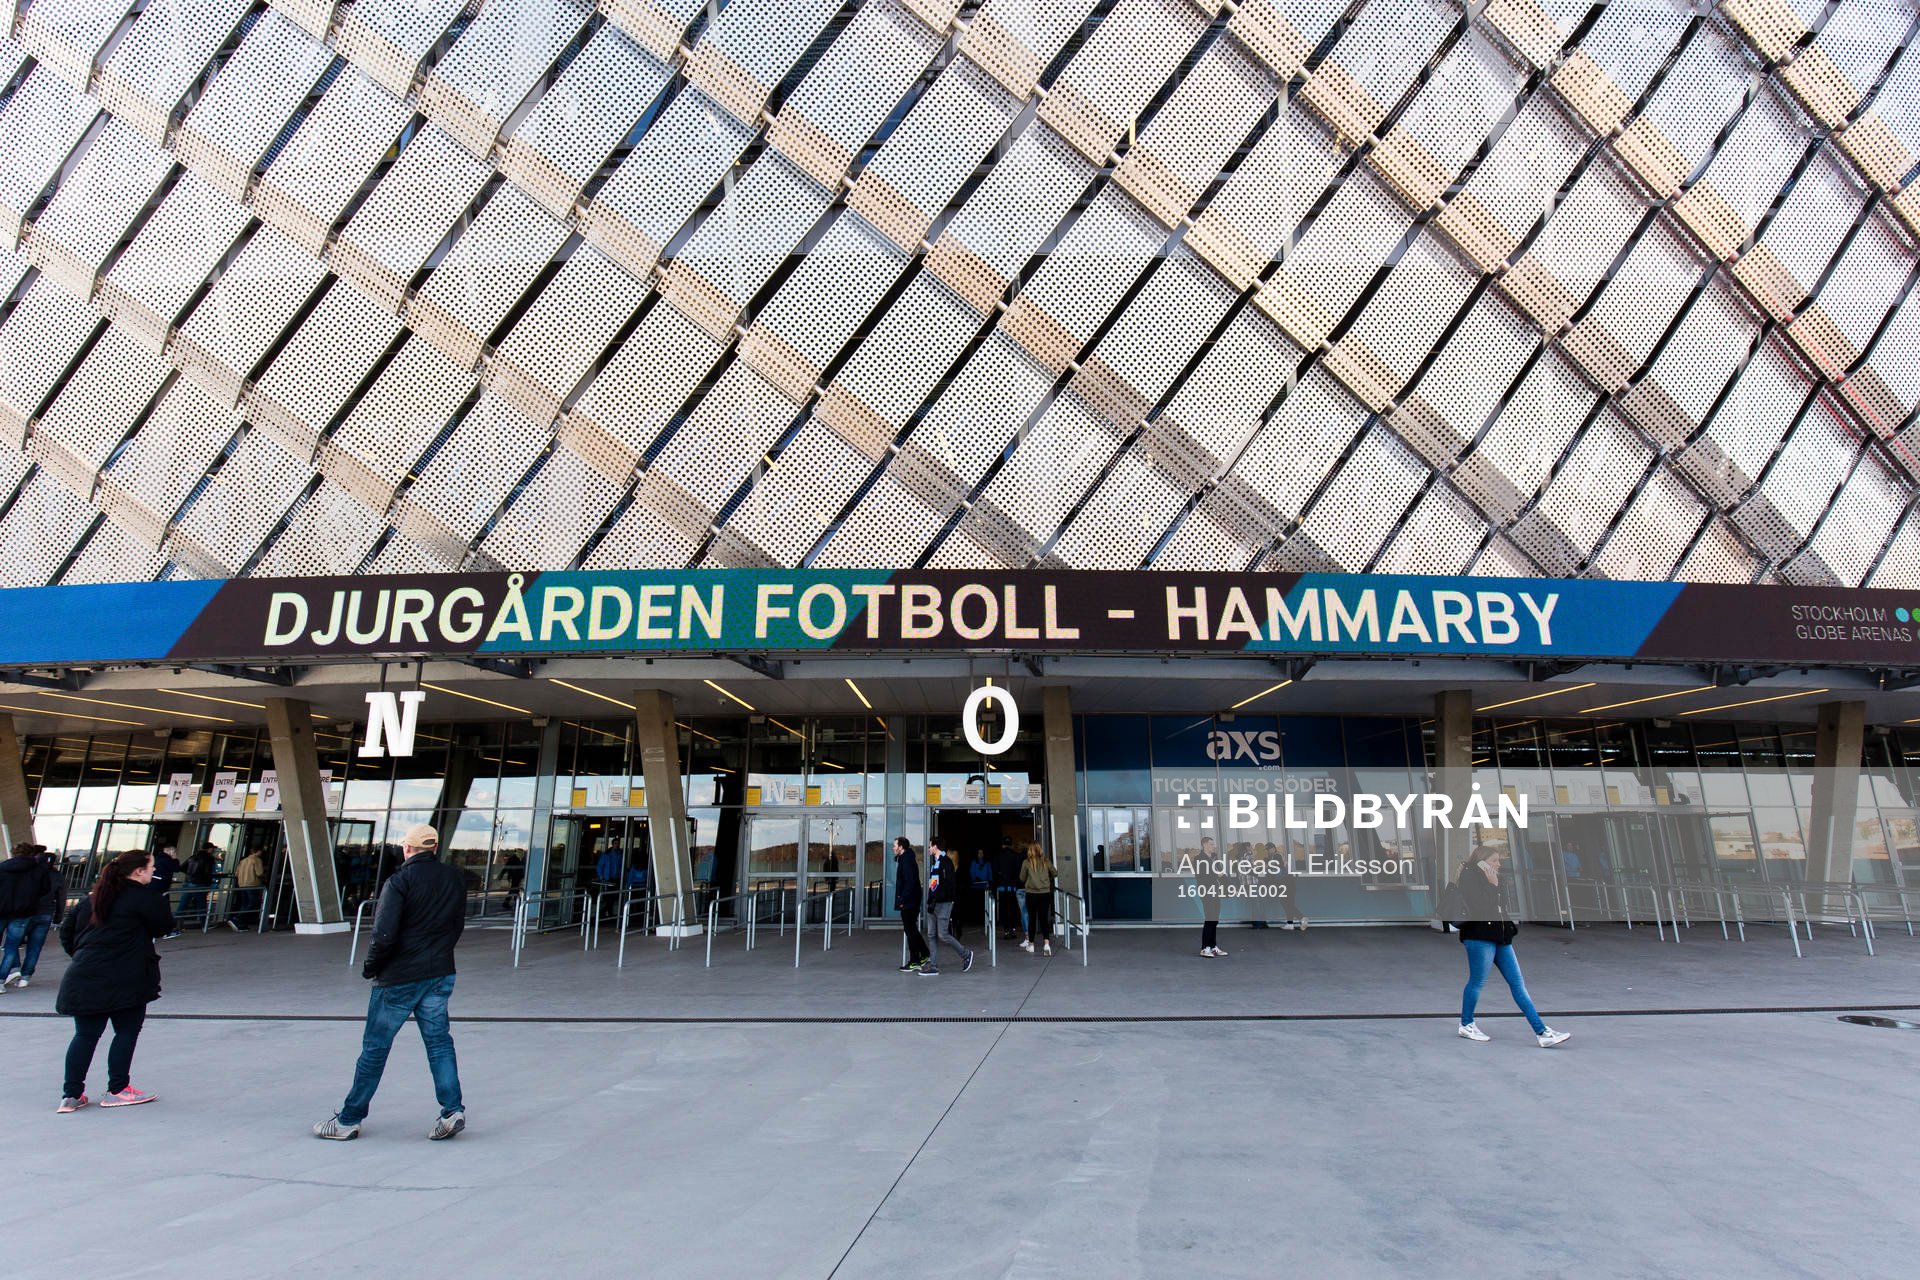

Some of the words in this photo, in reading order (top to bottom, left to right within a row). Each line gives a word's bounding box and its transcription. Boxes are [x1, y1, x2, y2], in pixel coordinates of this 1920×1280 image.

[264, 573, 725, 646] DJURGÅRDEN
[755, 583, 1080, 640] FOTBOLL
[1107, 609, 1135, 619] -
[1165, 586, 1559, 646] HAMMARBY
[1791, 605, 1888, 622] STOCKHOLM
[1796, 624, 1848, 640] GLOBE
[1852, 626, 1912, 642] ARENAS
[358, 691, 426, 758] N
[962, 685, 1019, 755] O
[1206, 730, 1281, 766] axs
[216, 778, 235, 786] ENTRE
[1154, 778, 1218, 793] TICKET
[1224, 778, 1269, 793] INFO
[1274, 774, 1337, 793] SÖDER
[217, 790, 228, 804] P
[263, 788, 275, 802] P
